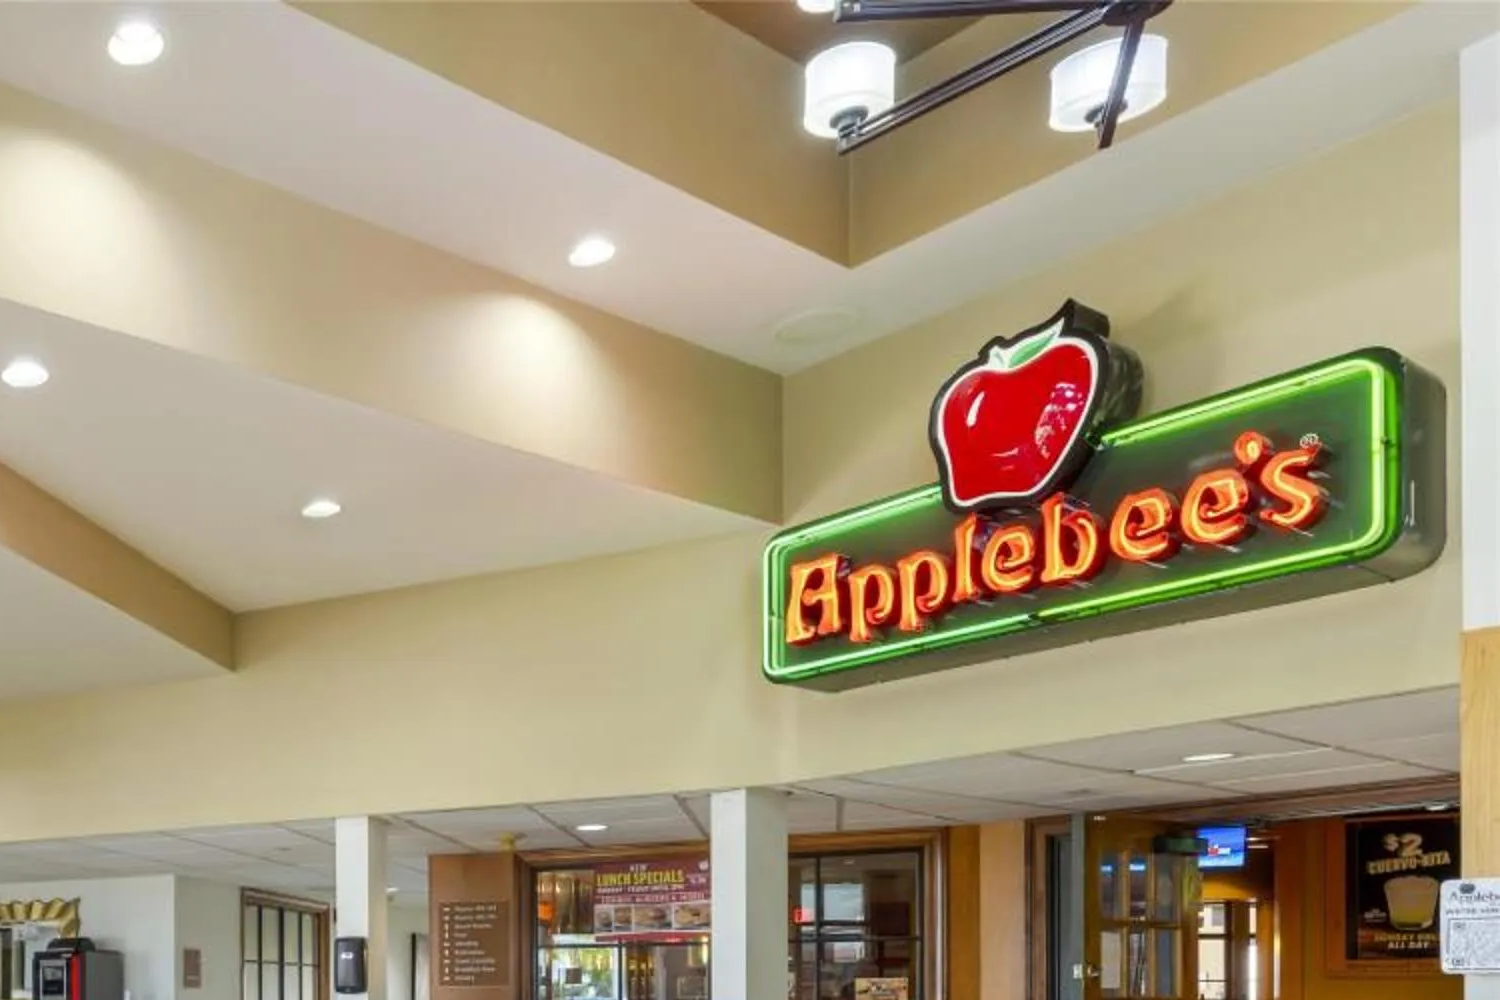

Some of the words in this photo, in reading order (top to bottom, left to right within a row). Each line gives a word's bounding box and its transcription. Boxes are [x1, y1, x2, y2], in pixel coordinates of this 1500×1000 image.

[786, 431, 1324, 644] Applebee's
[1384, 833, 1423, 858] $2
[596, 872, 631, 886] LUNCH
[632, 868, 686, 884] SPECIALS
